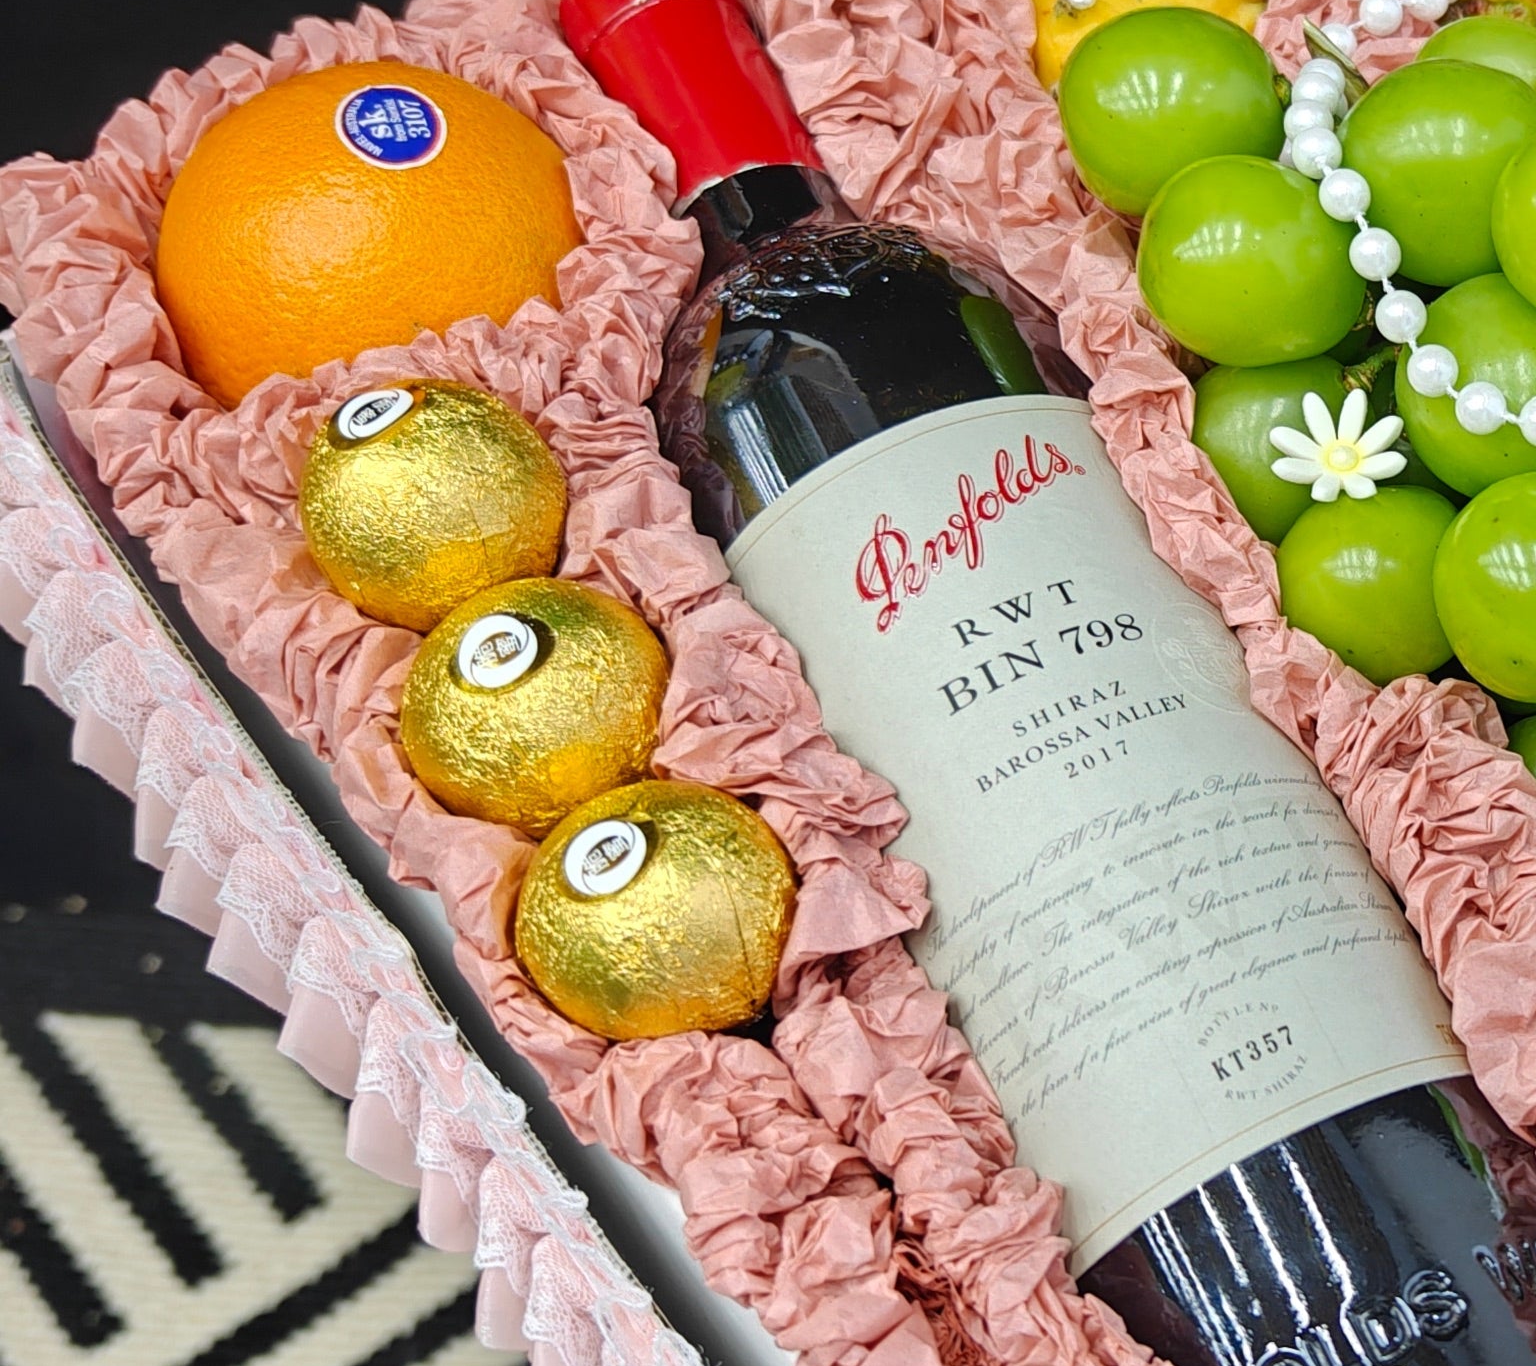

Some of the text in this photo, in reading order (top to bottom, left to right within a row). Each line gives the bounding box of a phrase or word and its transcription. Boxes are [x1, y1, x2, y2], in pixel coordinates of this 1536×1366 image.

[398, 99, 431, 138] 3107
[856, 434, 1077, 634] Penfolds
[938, 612, 1144, 718] BIN 798
[1011, 680, 1127, 739] SHIRAZ
[975, 693, 1189, 796] BAROSSA VALLEY
[1064, 740, 1131, 780] 2017
[948, 870, 1022, 938] development
[1112, 800, 1152, 839] fully
[1154, 786, 1200, 817] reflects
[1203, 772, 1261, 797] Penfolds
[1102, 864, 1116, 878] to
[1215, 811, 1238, 832] the
[1241, 802, 1279, 825] search
[1041, 919, 1074, 958] The
[1080, 885, 1160, 932] integration
[1188, 856, 1212, 880] the
[1218, 844, 1245, 868] rich
[1251, 841, 1292, 862] texture
[1297, 833, 1319, 850] and
[1045, 951, 1116, 1001] Barossa
[1119, 915, 1179, 951] Valley
[1188, 890, 1250, 920] Shiraz
[1256, 872, 1291, 895] with
[1298, 864, 1320, 884] the
[1058, 1003, 1108, 1039] delivers
[1111, 986, 1132, 1004] an
[1135, 953, 1191, 990] exciting
[1197, 924, 1267, 960] expression
[1287, 895, 1359, 924] Australian
[1040, 1072, 1070, 1110] form
[1103, 1026, 1131, 1063] fine
[1138, 1004, 1175, 1033] wine
[1198, 970, 1238, 1005] great
[1241, 952, 1298, 981] elegance
[1302, 936, 1328, 958] and
[1331, 929, 1383, 955] profound
[1197, 1001, 1255, 1048] BOTTLE
[1211, 1024, 1294, 1082] KT357
[1264, 1054, 1309, 1098] SHIRAZ
